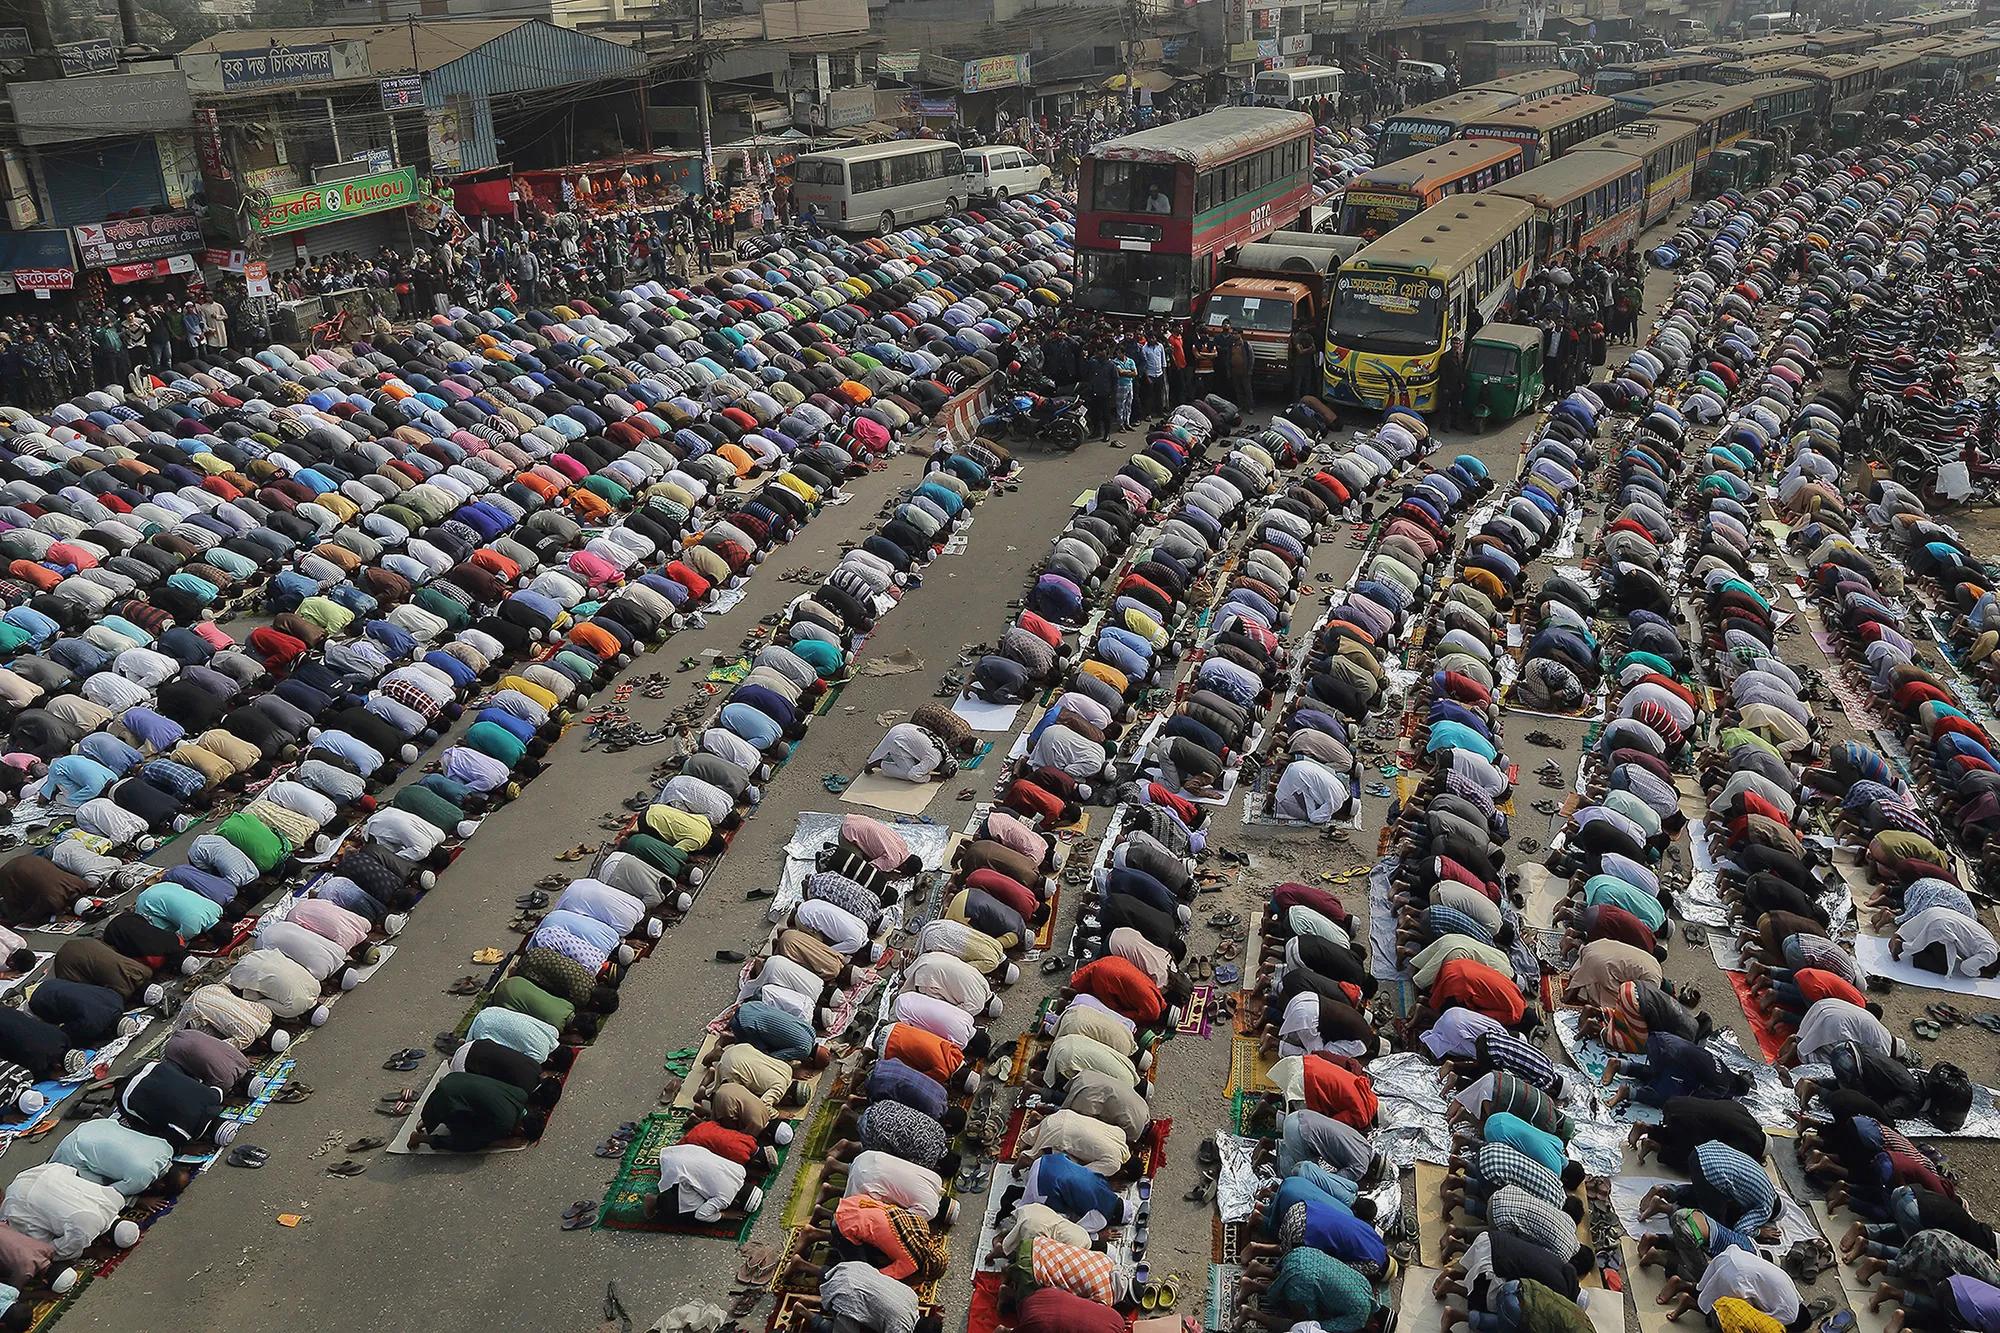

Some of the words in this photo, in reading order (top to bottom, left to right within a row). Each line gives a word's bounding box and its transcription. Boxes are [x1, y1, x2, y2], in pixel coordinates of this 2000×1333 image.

[85, 44, 113, 62] অফিস
[222, 58, 244, 80] হক
[245, 56, 267, 76] দন্ত
[268, 48, 330, 74] চিকিৎসালয়
[1387, 121, 1450, 136] ANANNA
[258, 192, 322, 229] ফুলকলি
[1250, 203, 1271, 234] BRTC
[15, 269, 74, 286] ফটোকপি
